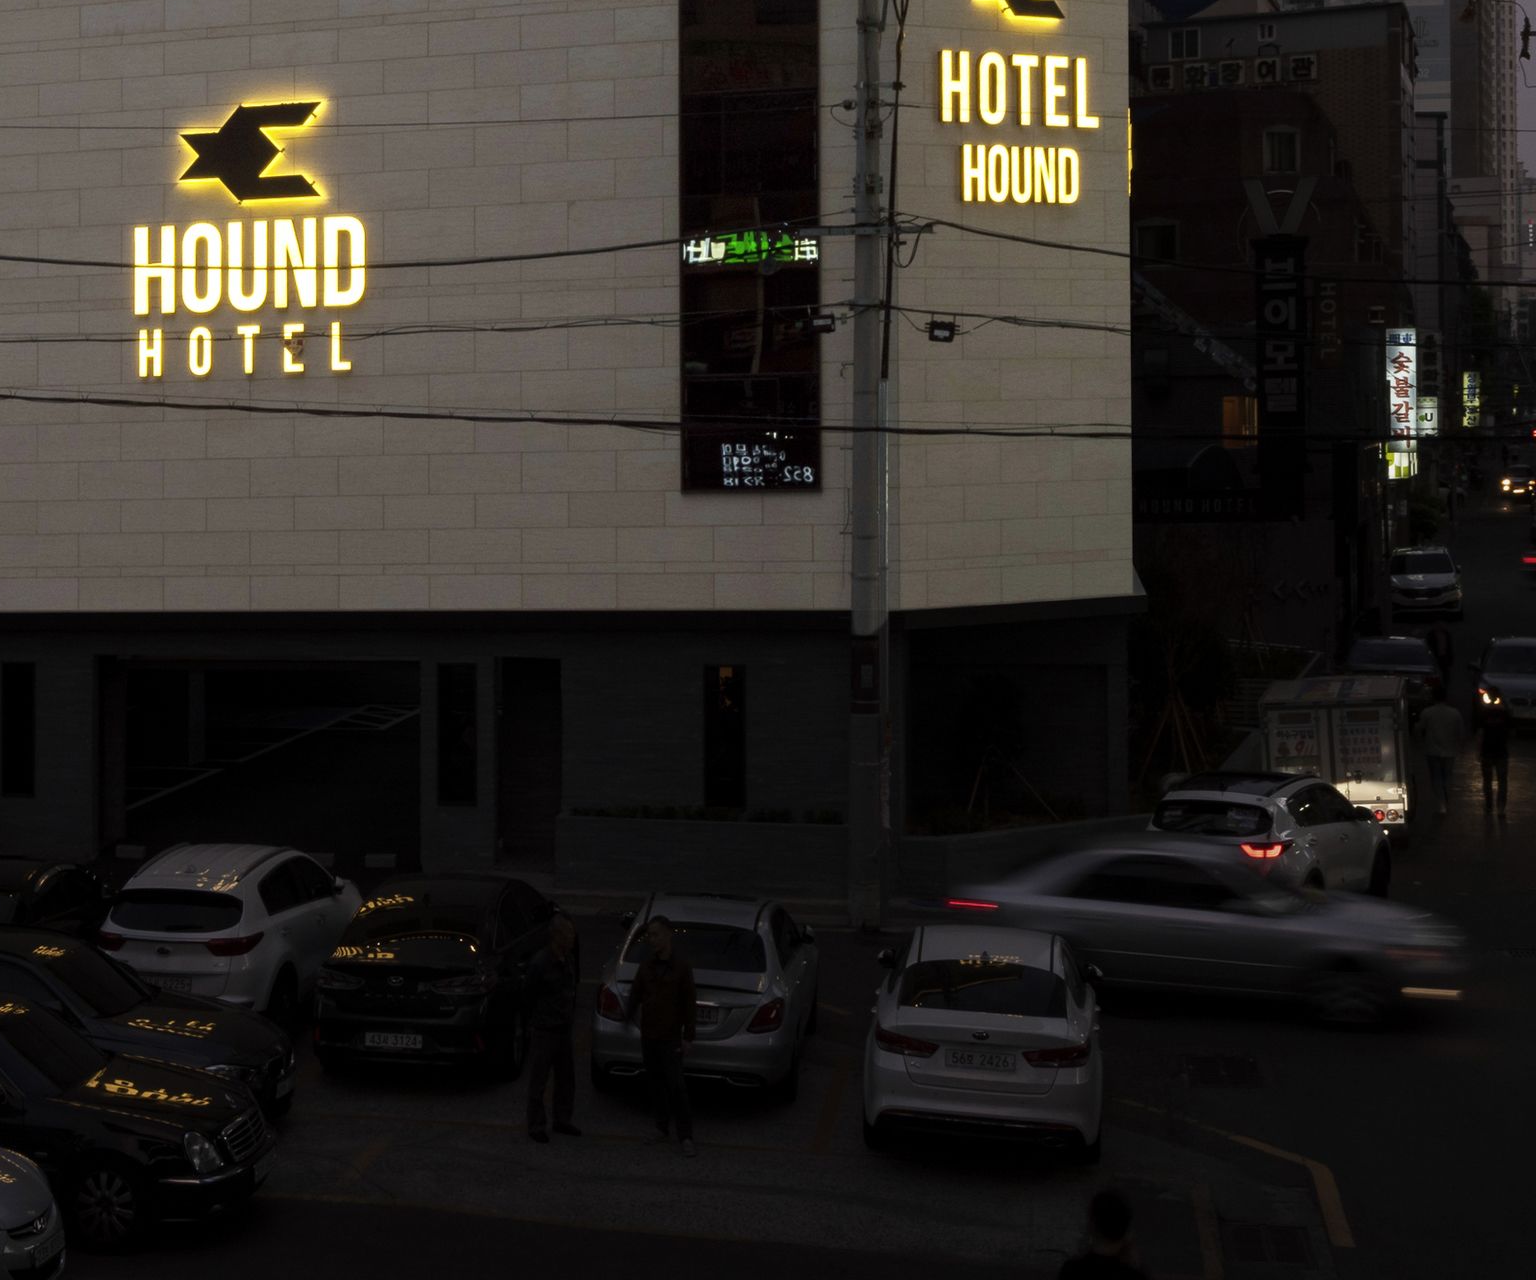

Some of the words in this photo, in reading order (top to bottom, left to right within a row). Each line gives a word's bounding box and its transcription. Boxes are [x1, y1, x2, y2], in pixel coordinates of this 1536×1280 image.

[940, 49, 1100, 129] HOTEL
[962, 143, 1081, 204] HOUND
[133, 215, 366, 316] HOUND
[138, 321, 352, 378] HOTEL
[979, 1054, 1009, 1068] 2426
